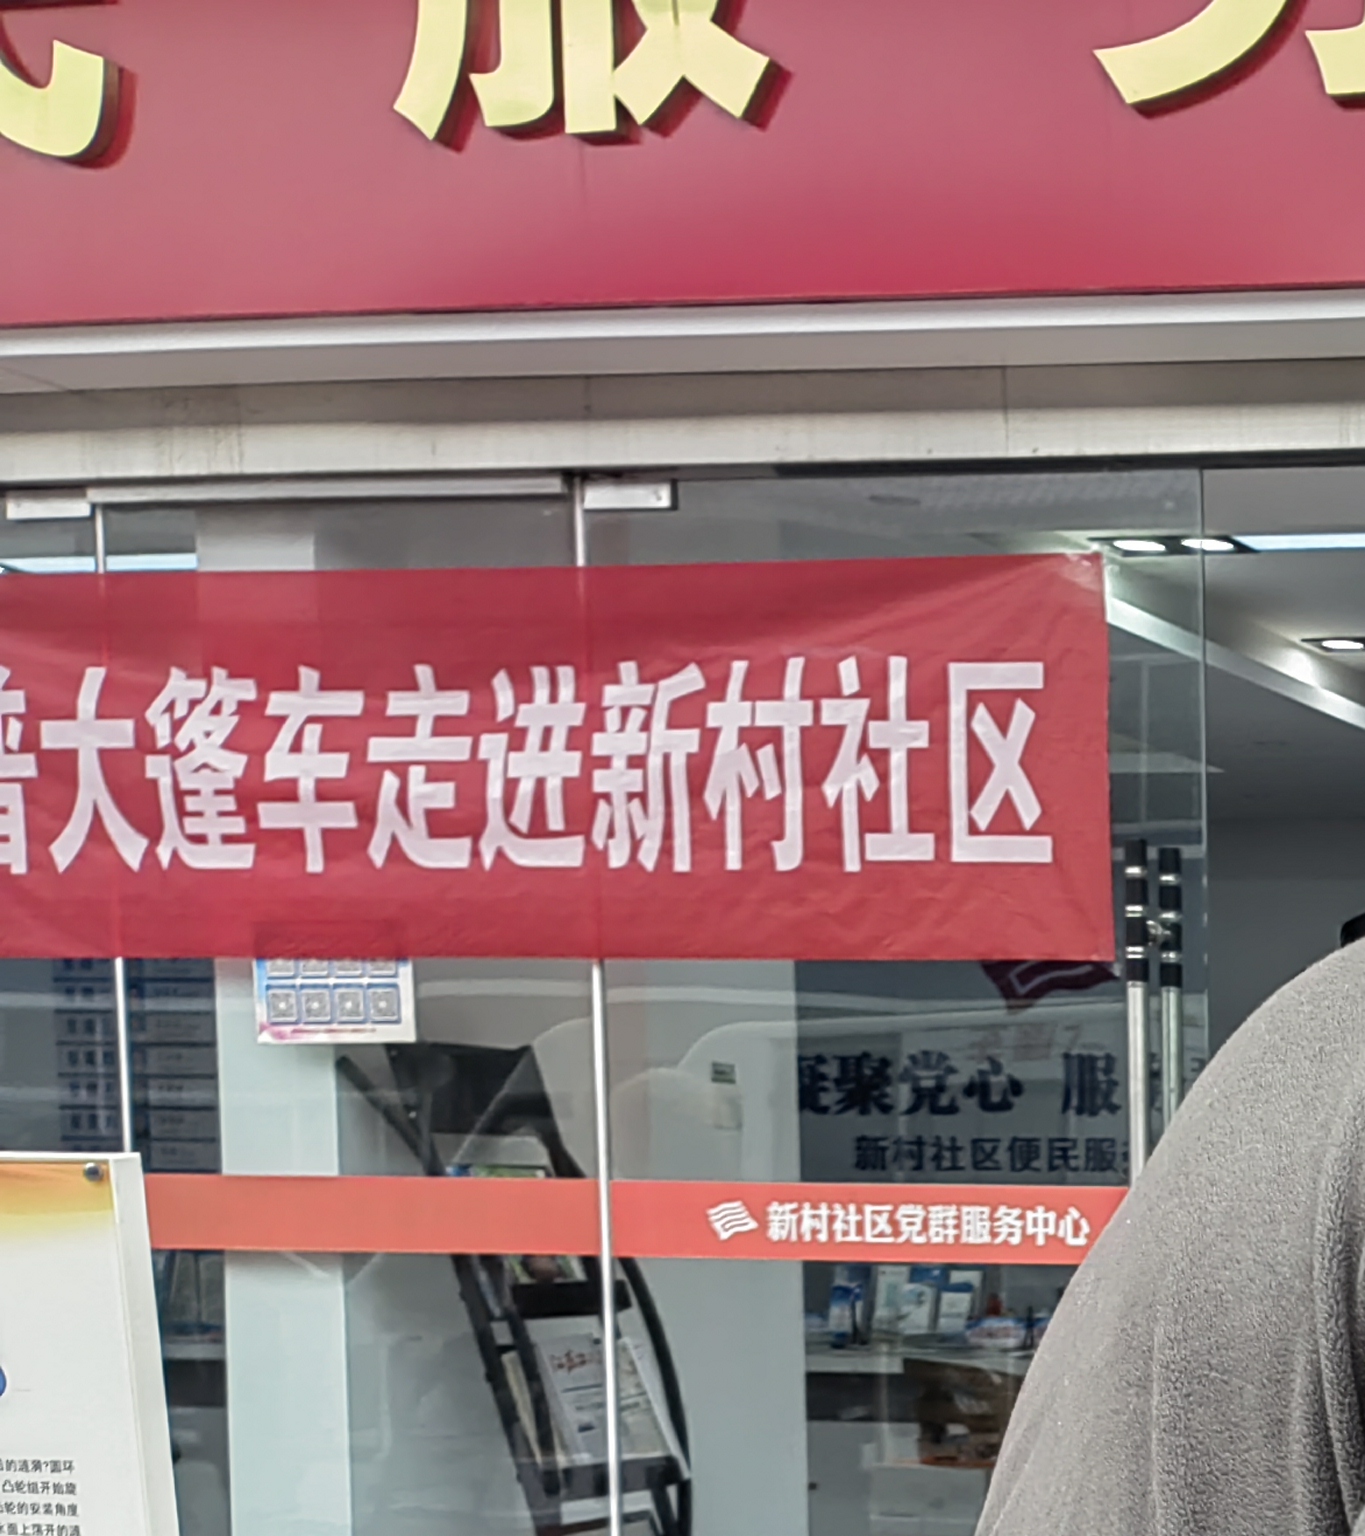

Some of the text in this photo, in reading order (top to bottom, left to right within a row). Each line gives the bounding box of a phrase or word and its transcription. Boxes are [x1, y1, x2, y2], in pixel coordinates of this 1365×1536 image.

[855, 1134, 1129, 1176] 新村社区便民服
[766, 1202, 1090, 1247] 新村社区党群服务中心
